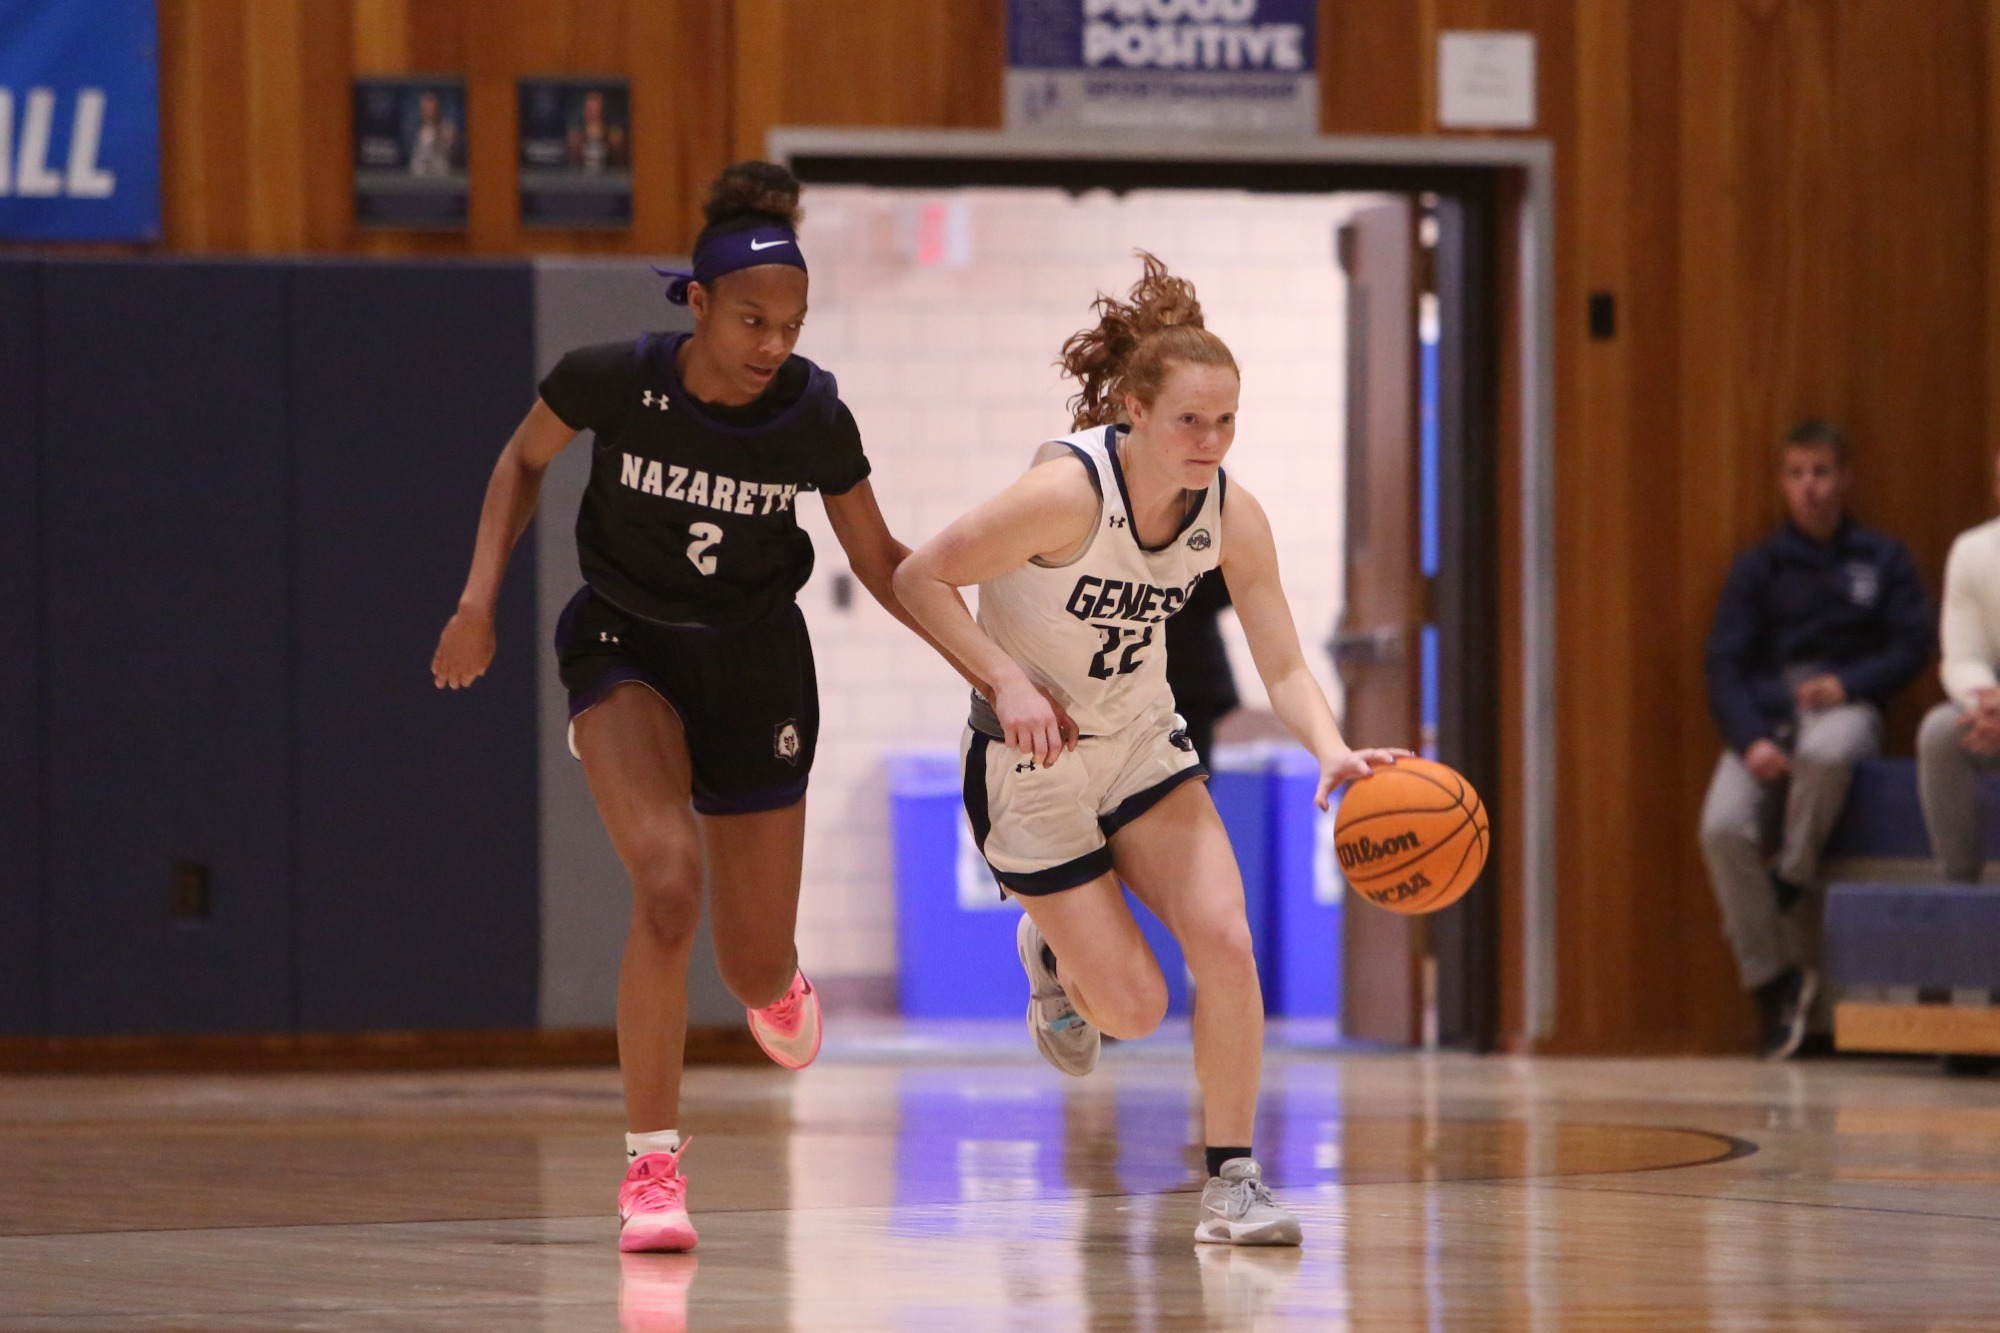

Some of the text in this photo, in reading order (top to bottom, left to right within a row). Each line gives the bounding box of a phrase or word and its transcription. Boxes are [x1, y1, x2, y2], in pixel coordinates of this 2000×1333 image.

[1083, 24, 1303, 68] POSITIVE
[686, 521, 724, 576] 2
[1066, 574, 1200, 623] GENES
[1088, 624, 1153, 680] 22
[1336, 831, 1420, 870] Wilson
